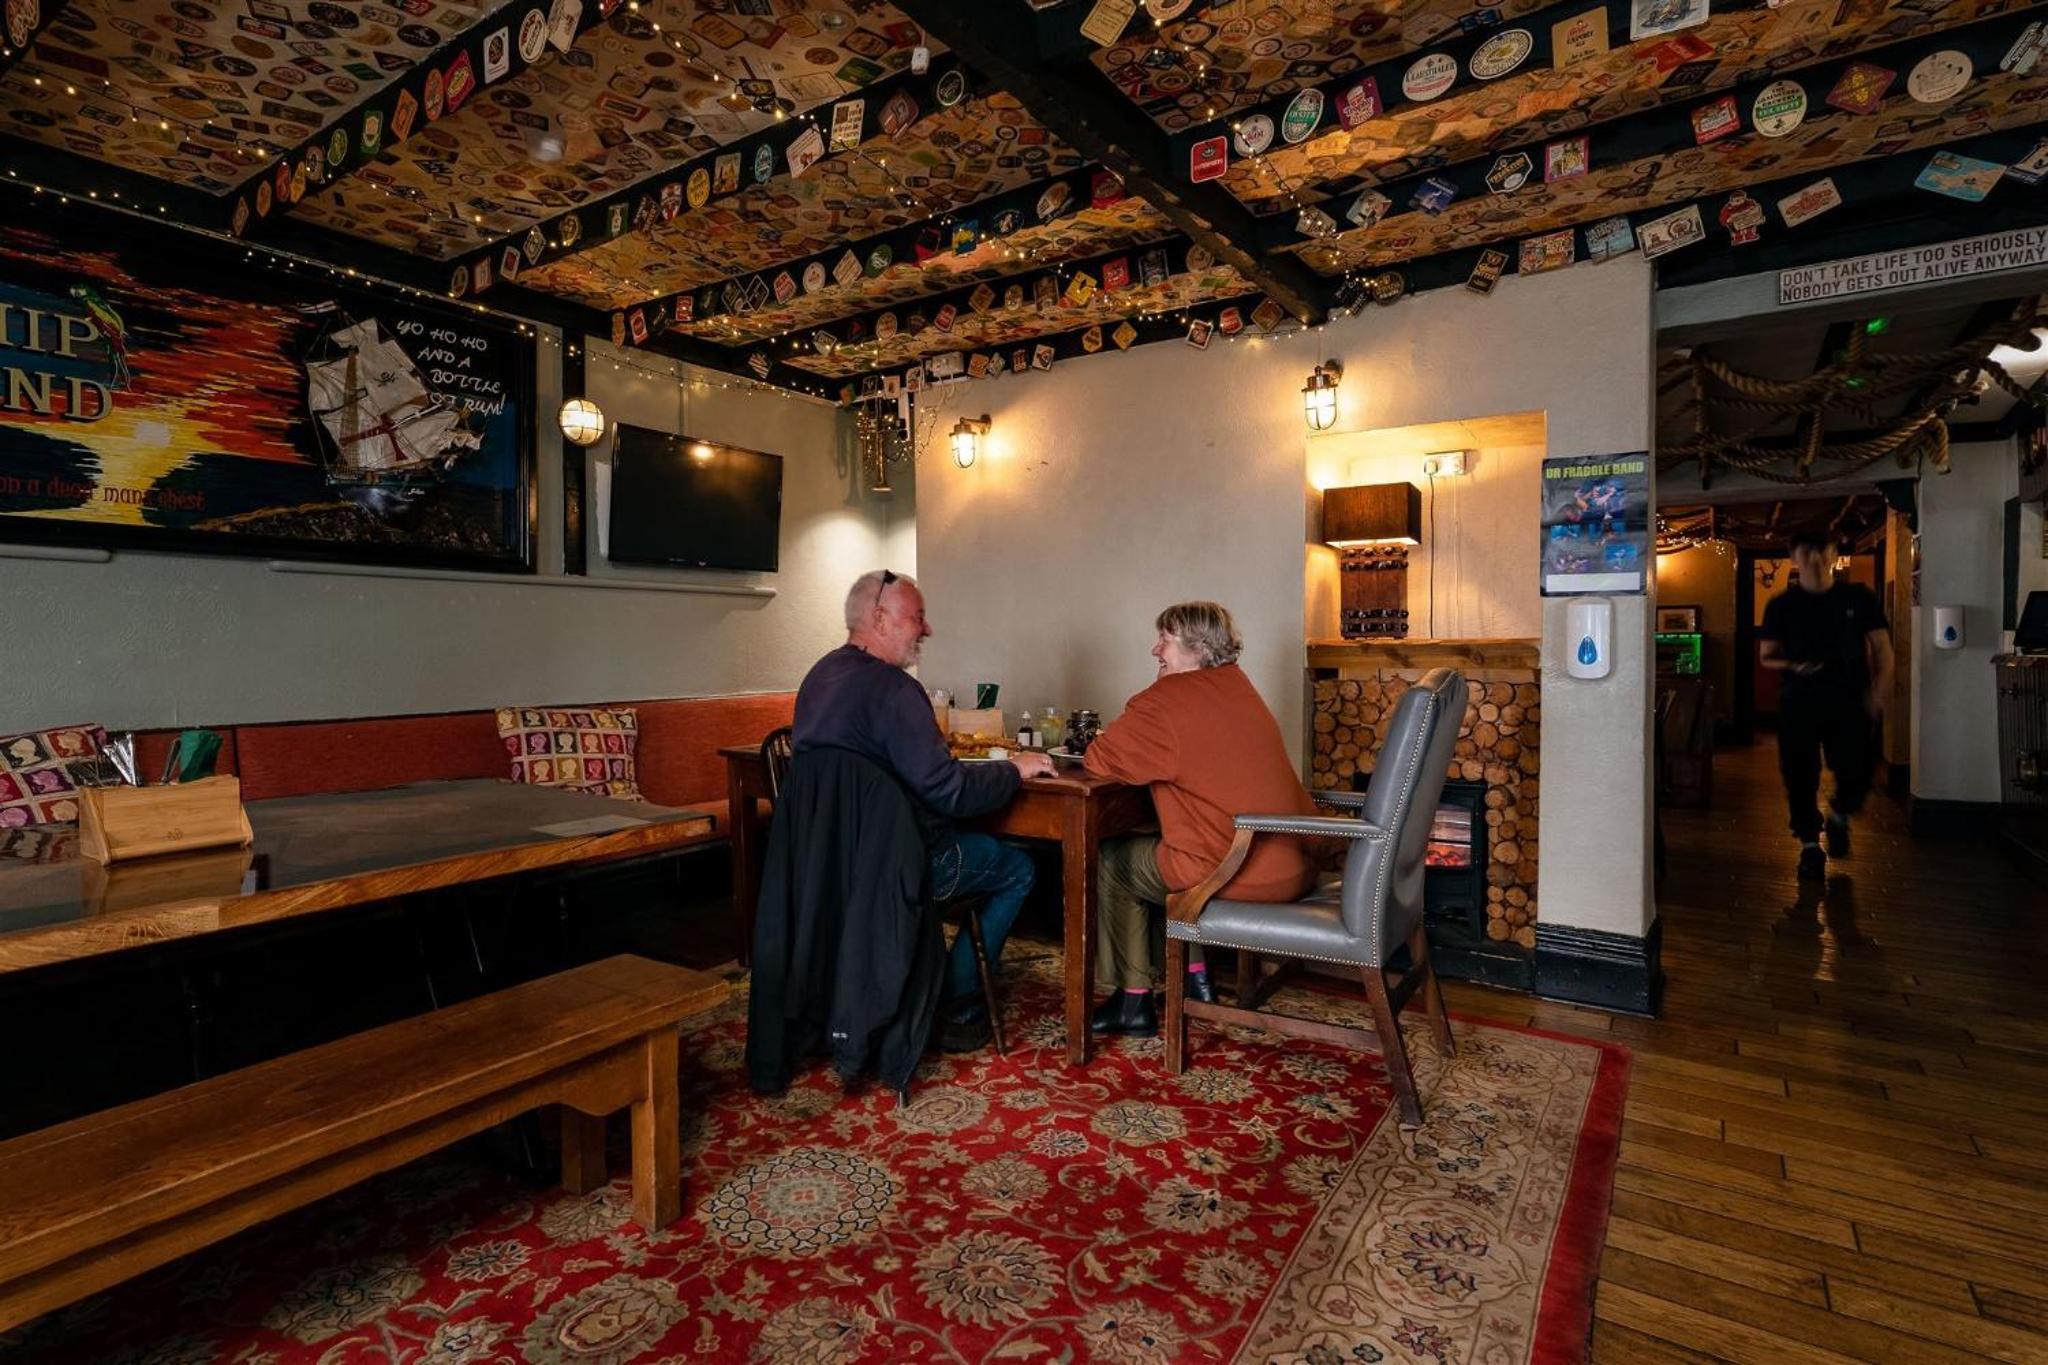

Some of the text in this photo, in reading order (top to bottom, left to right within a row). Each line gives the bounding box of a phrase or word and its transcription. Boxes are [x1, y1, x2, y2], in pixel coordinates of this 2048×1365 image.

[1783, 230, 2046, 287] DON'T TAKE LIFE TOO SERIOUSLY
[1783, 247, 2046, 301] NOBODY GETS OUT ALIVE ANYWAY
[396, 320, 487, 351] YO HO HO
[417, 346, 472, 368] AND A
[429, 368, 501, 394] BOTTLE
[463, 393, 506, 416] RUM!
